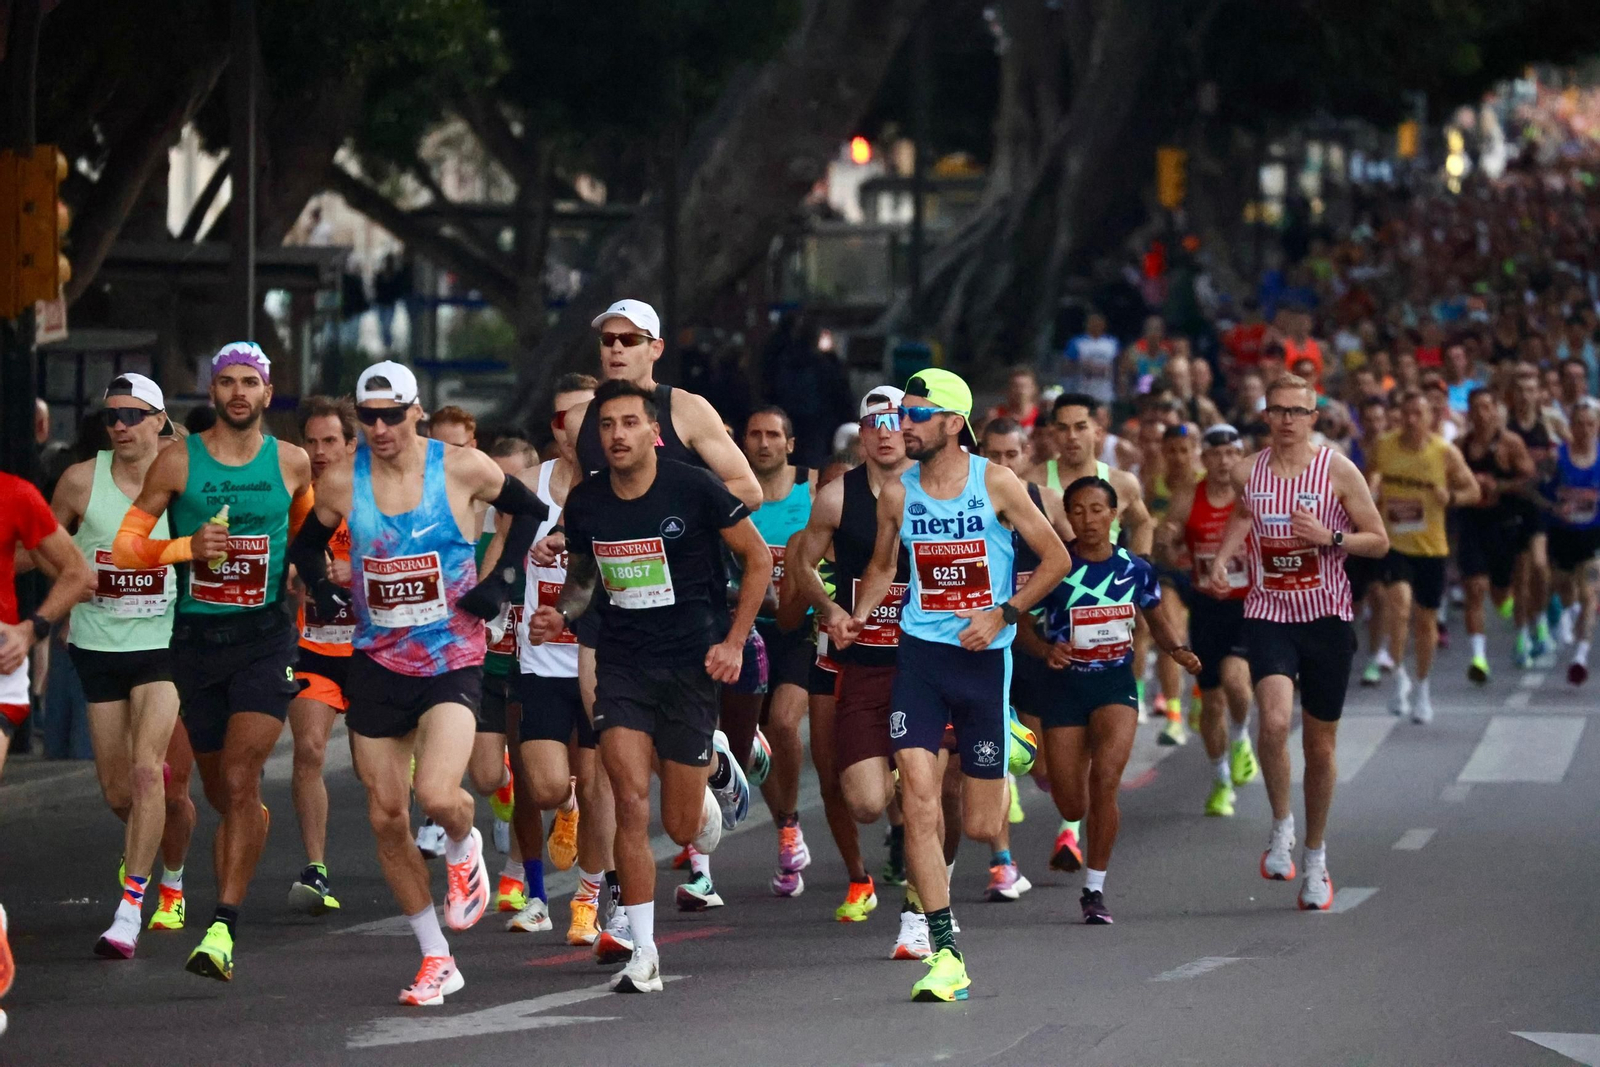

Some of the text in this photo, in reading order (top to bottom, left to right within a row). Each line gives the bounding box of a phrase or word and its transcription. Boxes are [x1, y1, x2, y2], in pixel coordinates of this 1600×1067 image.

[202, 482, 217, 492] La
[911, 511, 985, 539] nerja
[227, 539, 265, 551] NERALI
[608, 542, 657, 556] GENERALI
[930, 543, 980, 556] GENERALI
[378, 558, 434, 574] GENERALI
[1272, 556, 1302, 567] 5373
[610, 564, 651, 579] 18057
[932, 566, 967, 580] 6251
[109, 574, 153, 587] 14160
[378, 581, 425, 598] 17212
[871, 606, 900, 618] 598
[1088, 606, 1131, 618] GENERALI
